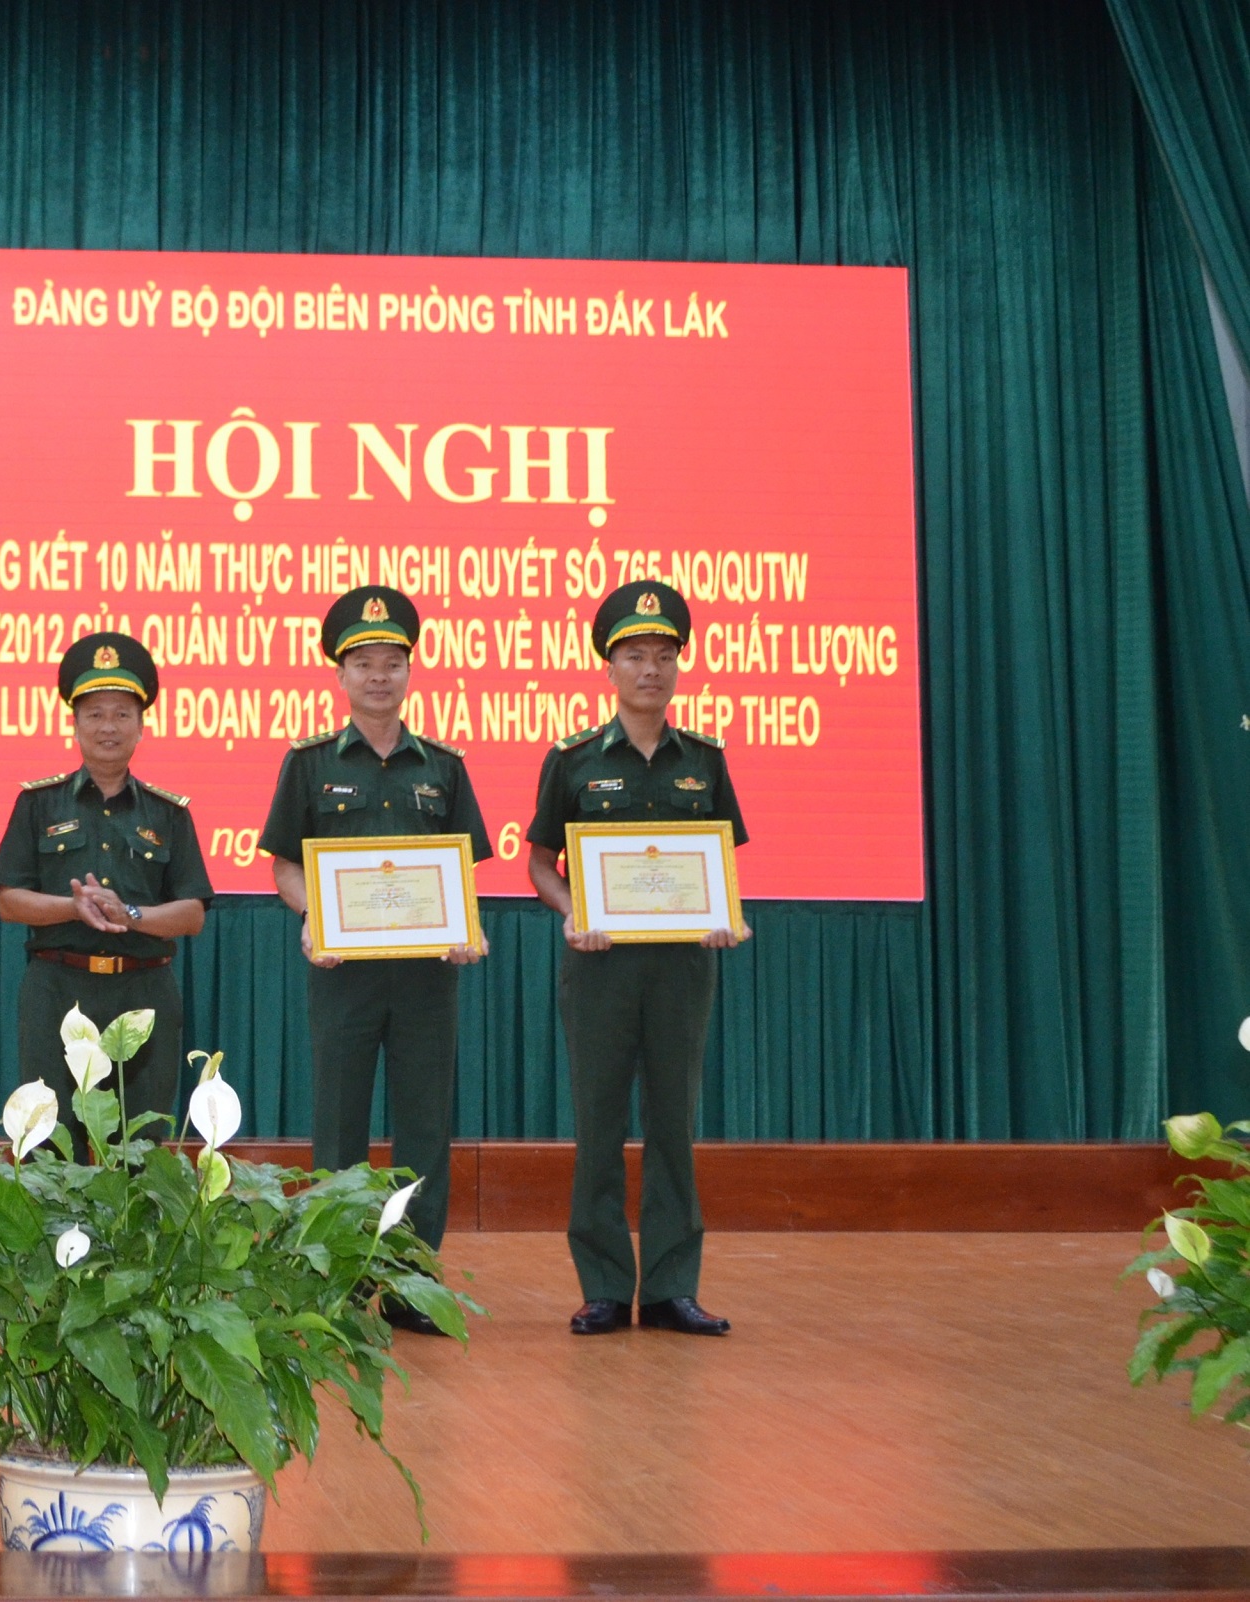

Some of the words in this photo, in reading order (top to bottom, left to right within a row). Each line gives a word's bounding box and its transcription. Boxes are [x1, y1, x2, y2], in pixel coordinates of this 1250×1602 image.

[12, 279, 108, 327] ĐẢNG
[118, 280, 162, 327] UỶ
[171, 285, 218, 337] BỘ
[226, 285, 284, 338] ĐỘI
[294, 282, 369, 331] BIÊN
[379, 285, 495, 333] PHÒNG
[503, 288, 577, 335] TỈNH
[585, 289, 655, 336] ĐẮK
[664, 291, 729, 338] LẮK
[125, 406, 321, 522] HỘI
[348, 422, 616, 528] NGHỊ
[29, 529, 88, 591] KẾT
[96, 541, 128, 592] 10
[135, 529, 201, 592] NĂM
[209, 543, 293, 606] THỰC
[379, 545, 451, 609] NGHỊ
[458, 536, 557, 600] QUYẾT
[565, 537, 607, 599] SỐ
[614, 549, 808, 604] 765-NQ/QUTW
[142, 602, 227, 668] QUÂN
[237, 604, 277, 666] ỦY
[409, 618, 487, 670] ƠNG
[494, 608, 533, 670] VỀ
[541, 607, 603, 671] NÂN
[704, 612, 783, 674] CHẤT
[791, 624, 898, 687] LƯỢNG
[1, 686, 75, 749] LUYỆ
[174, 687, 261, 751] ĐOẠN
[269, 689, 334, 740] 2013
[431, 678, 474, 742] VÀ
[481, 681, 589, 743] NHỮNG
[670, 683, 734, 741] TIẾP
[740, 696, 820, 747] THEO
[497, 821, 521, 861] 6
